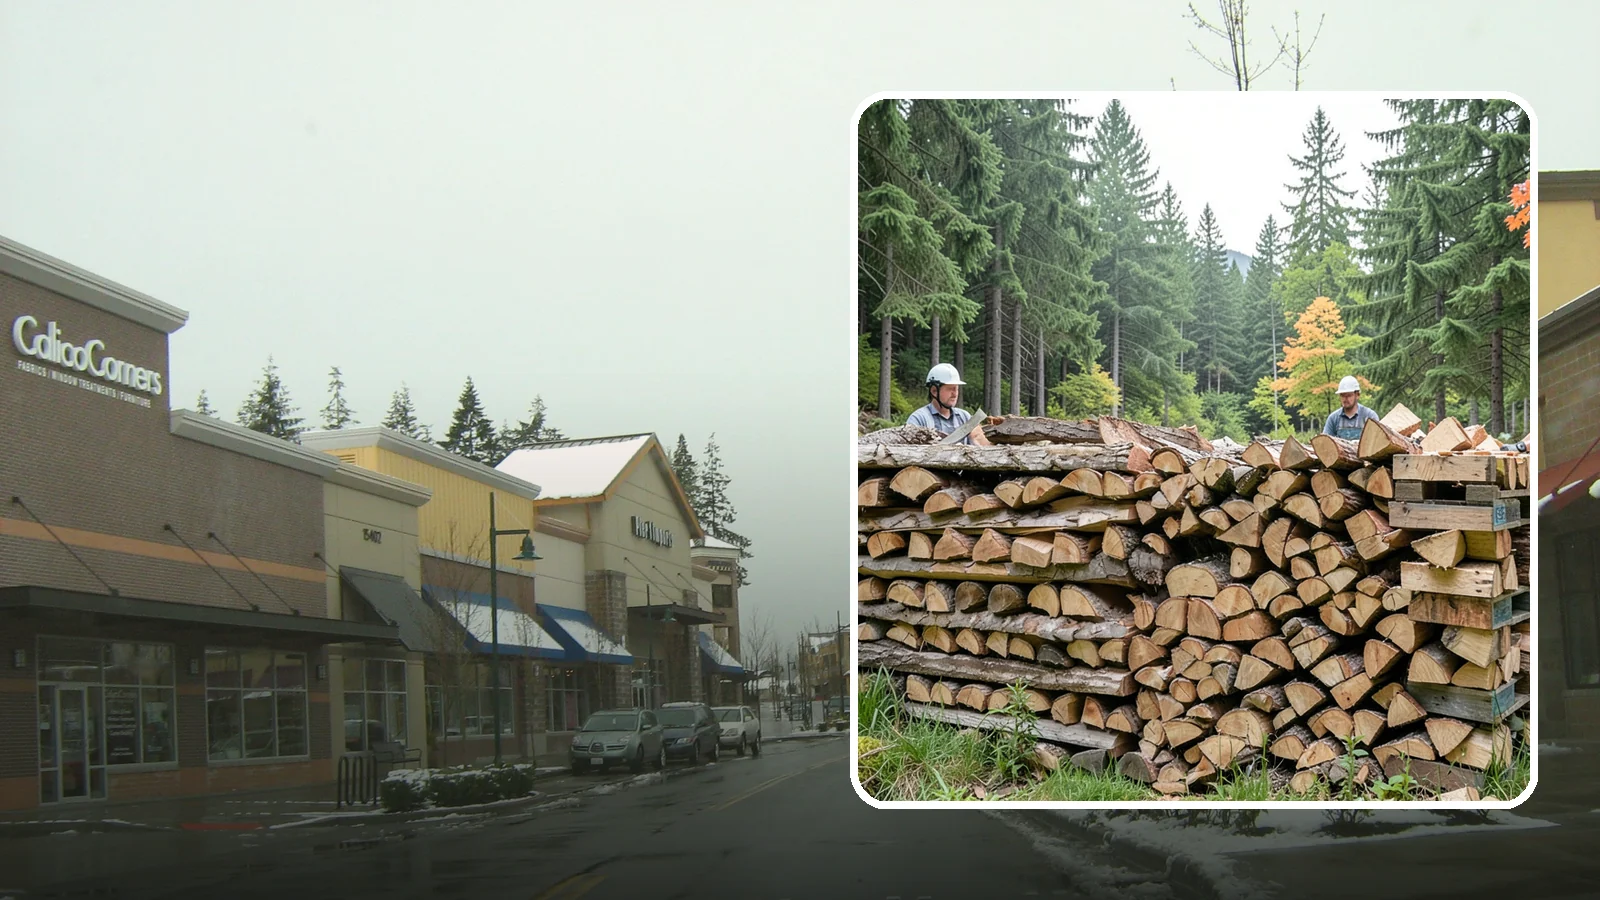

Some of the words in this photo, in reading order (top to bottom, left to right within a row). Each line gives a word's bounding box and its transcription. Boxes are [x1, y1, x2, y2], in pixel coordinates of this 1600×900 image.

[17, 360, 47, 377] FABRICS
[51, 371, 78, 386] WINDOW
[79, 378, 117, 398] TREATMENTS
